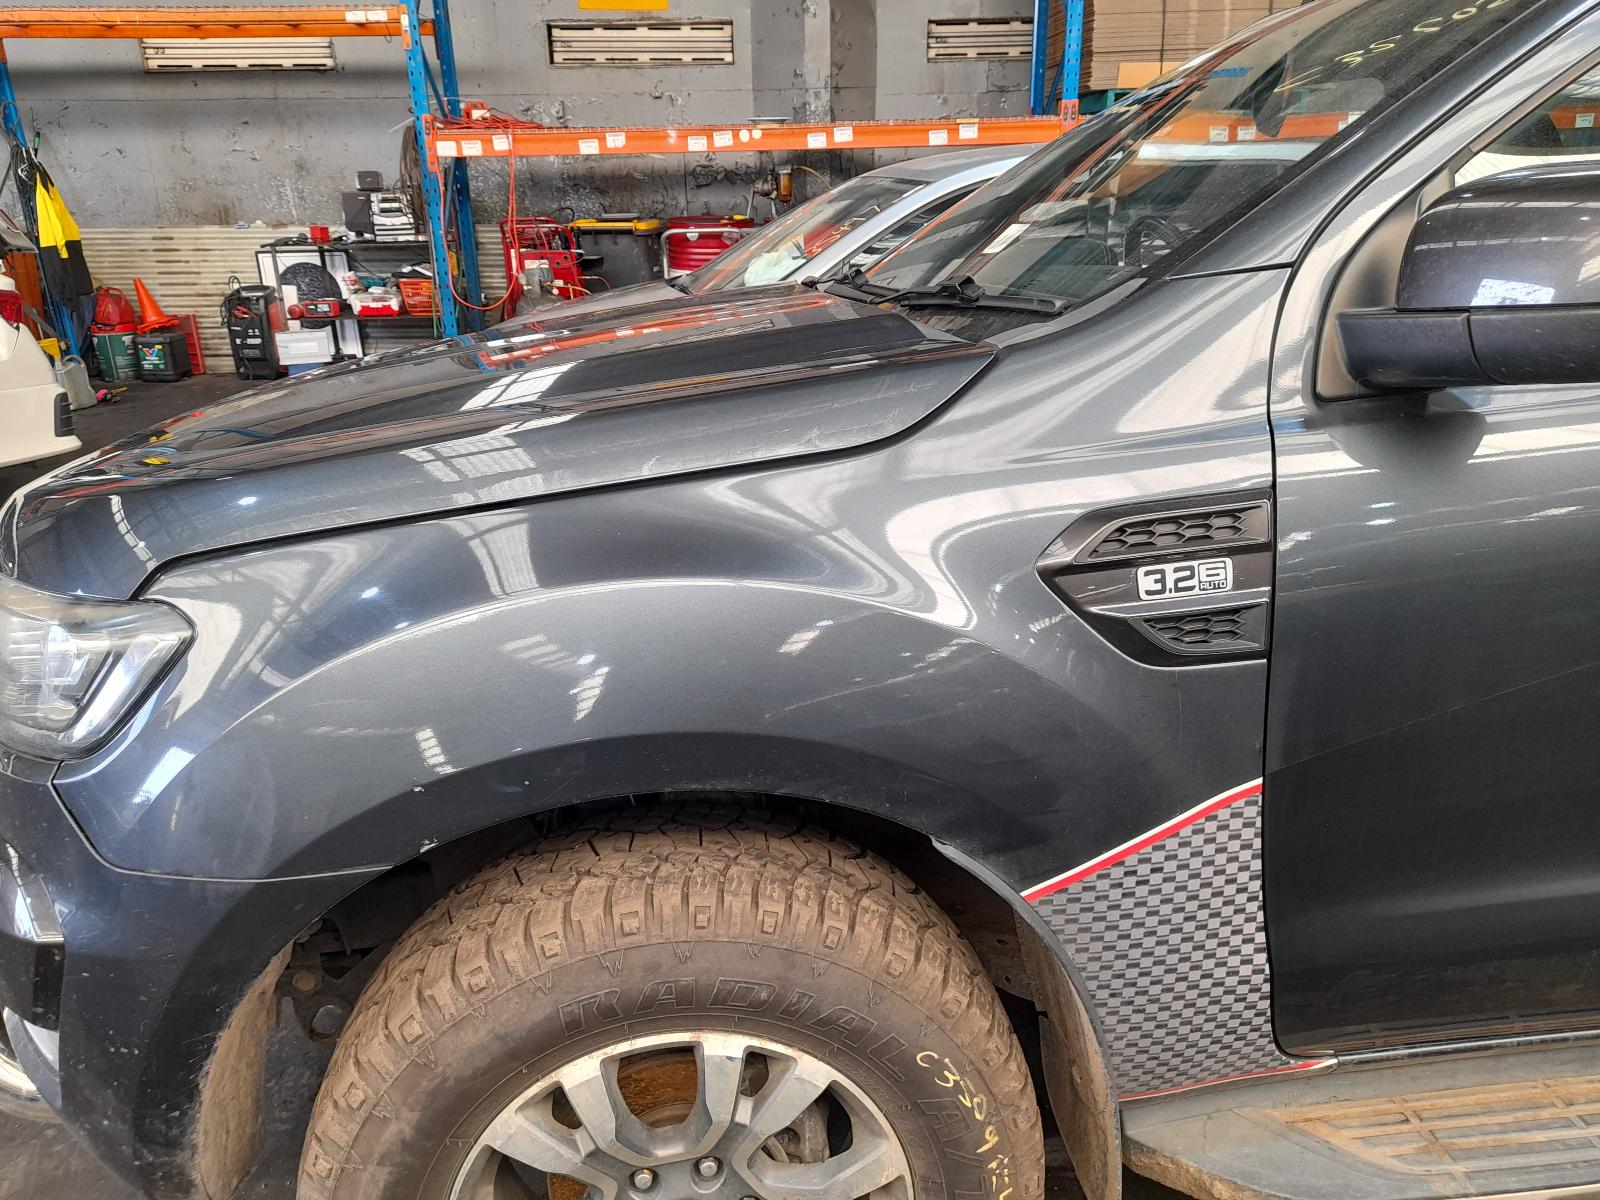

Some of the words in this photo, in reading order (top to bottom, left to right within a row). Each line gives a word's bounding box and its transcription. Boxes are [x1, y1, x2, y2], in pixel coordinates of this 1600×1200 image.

[1143, 564, 1197, 596] 3.2
[1199, 579, 1228, 591] AUTO
[558, 977, 907, 1082] RADIAL
